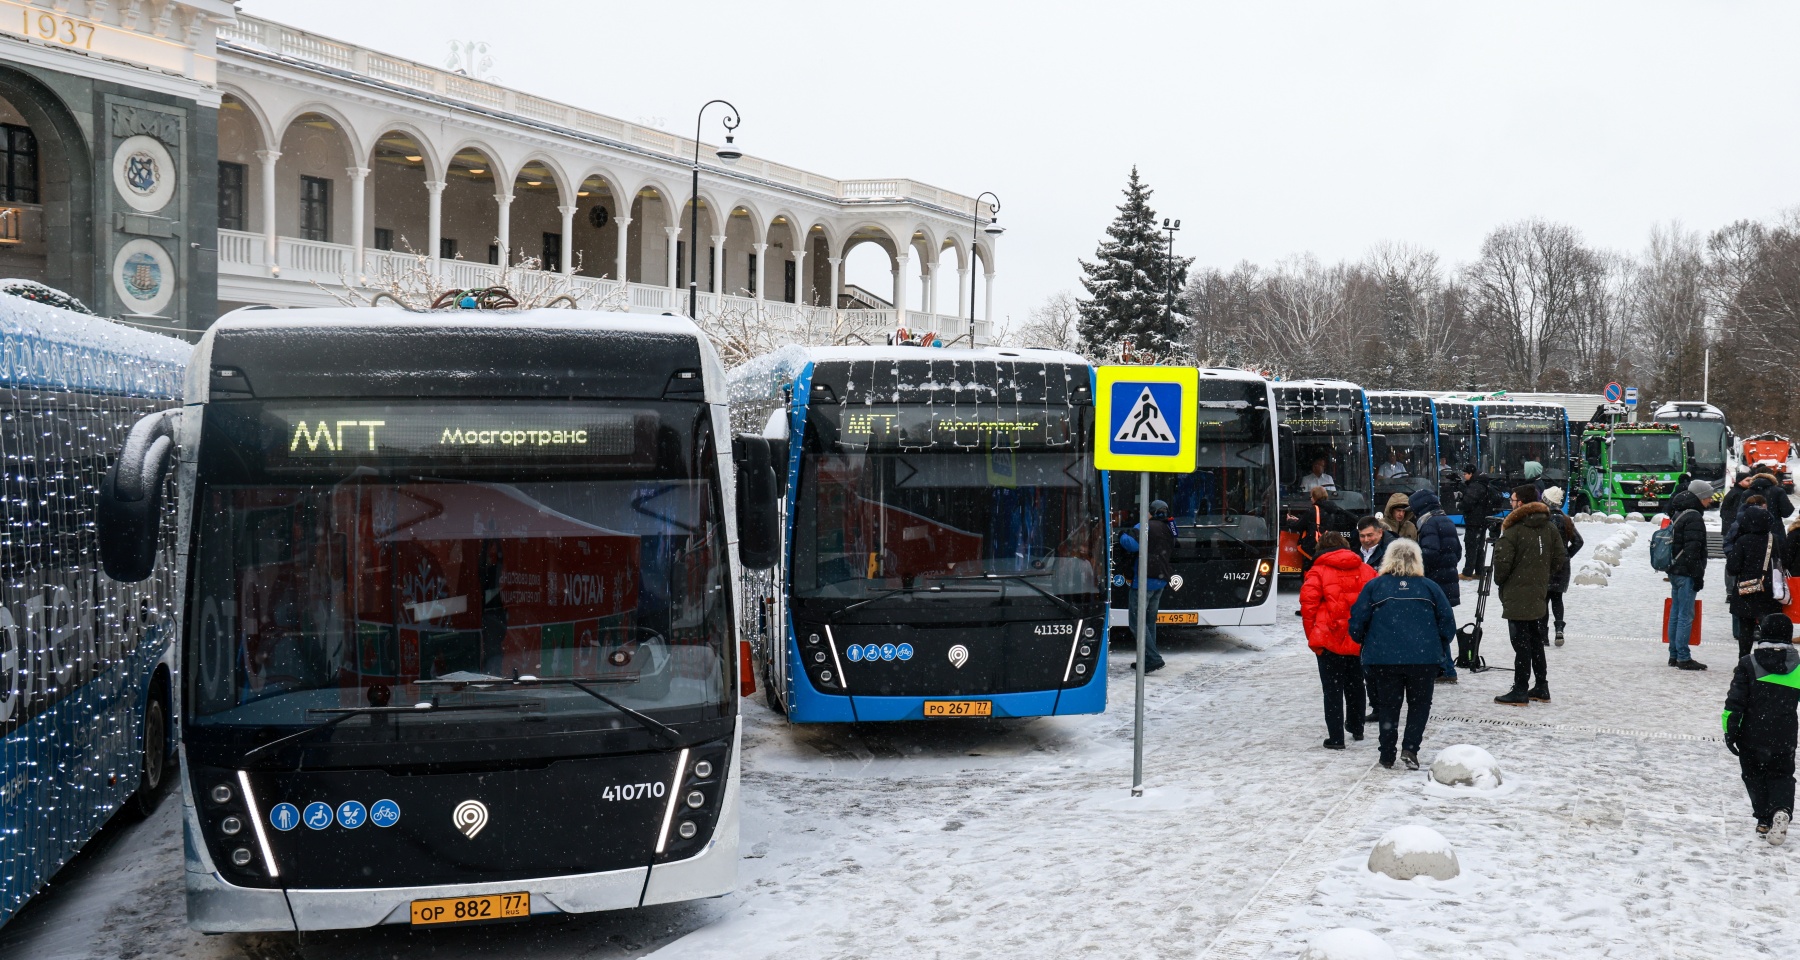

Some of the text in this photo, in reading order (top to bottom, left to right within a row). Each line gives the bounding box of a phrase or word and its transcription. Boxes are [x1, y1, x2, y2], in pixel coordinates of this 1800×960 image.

[23, 10, 95, 49] 1937
[848, 414, 896, 434] МГТ
[291, 420, 587, 451] МГТ Мосгортранс
[1223, 572, 1250, 580] 411427
[1169, 614, 1184, 622] 495
[1034, 625, 1073, 635] 411338
[949, 703, 970, 714] 267
[976, 702, 988, 710] 77
[602, 781, 665, 801] 410710
[454, 899, 491, 918] 882
[503, 895, 522, 909] 77
